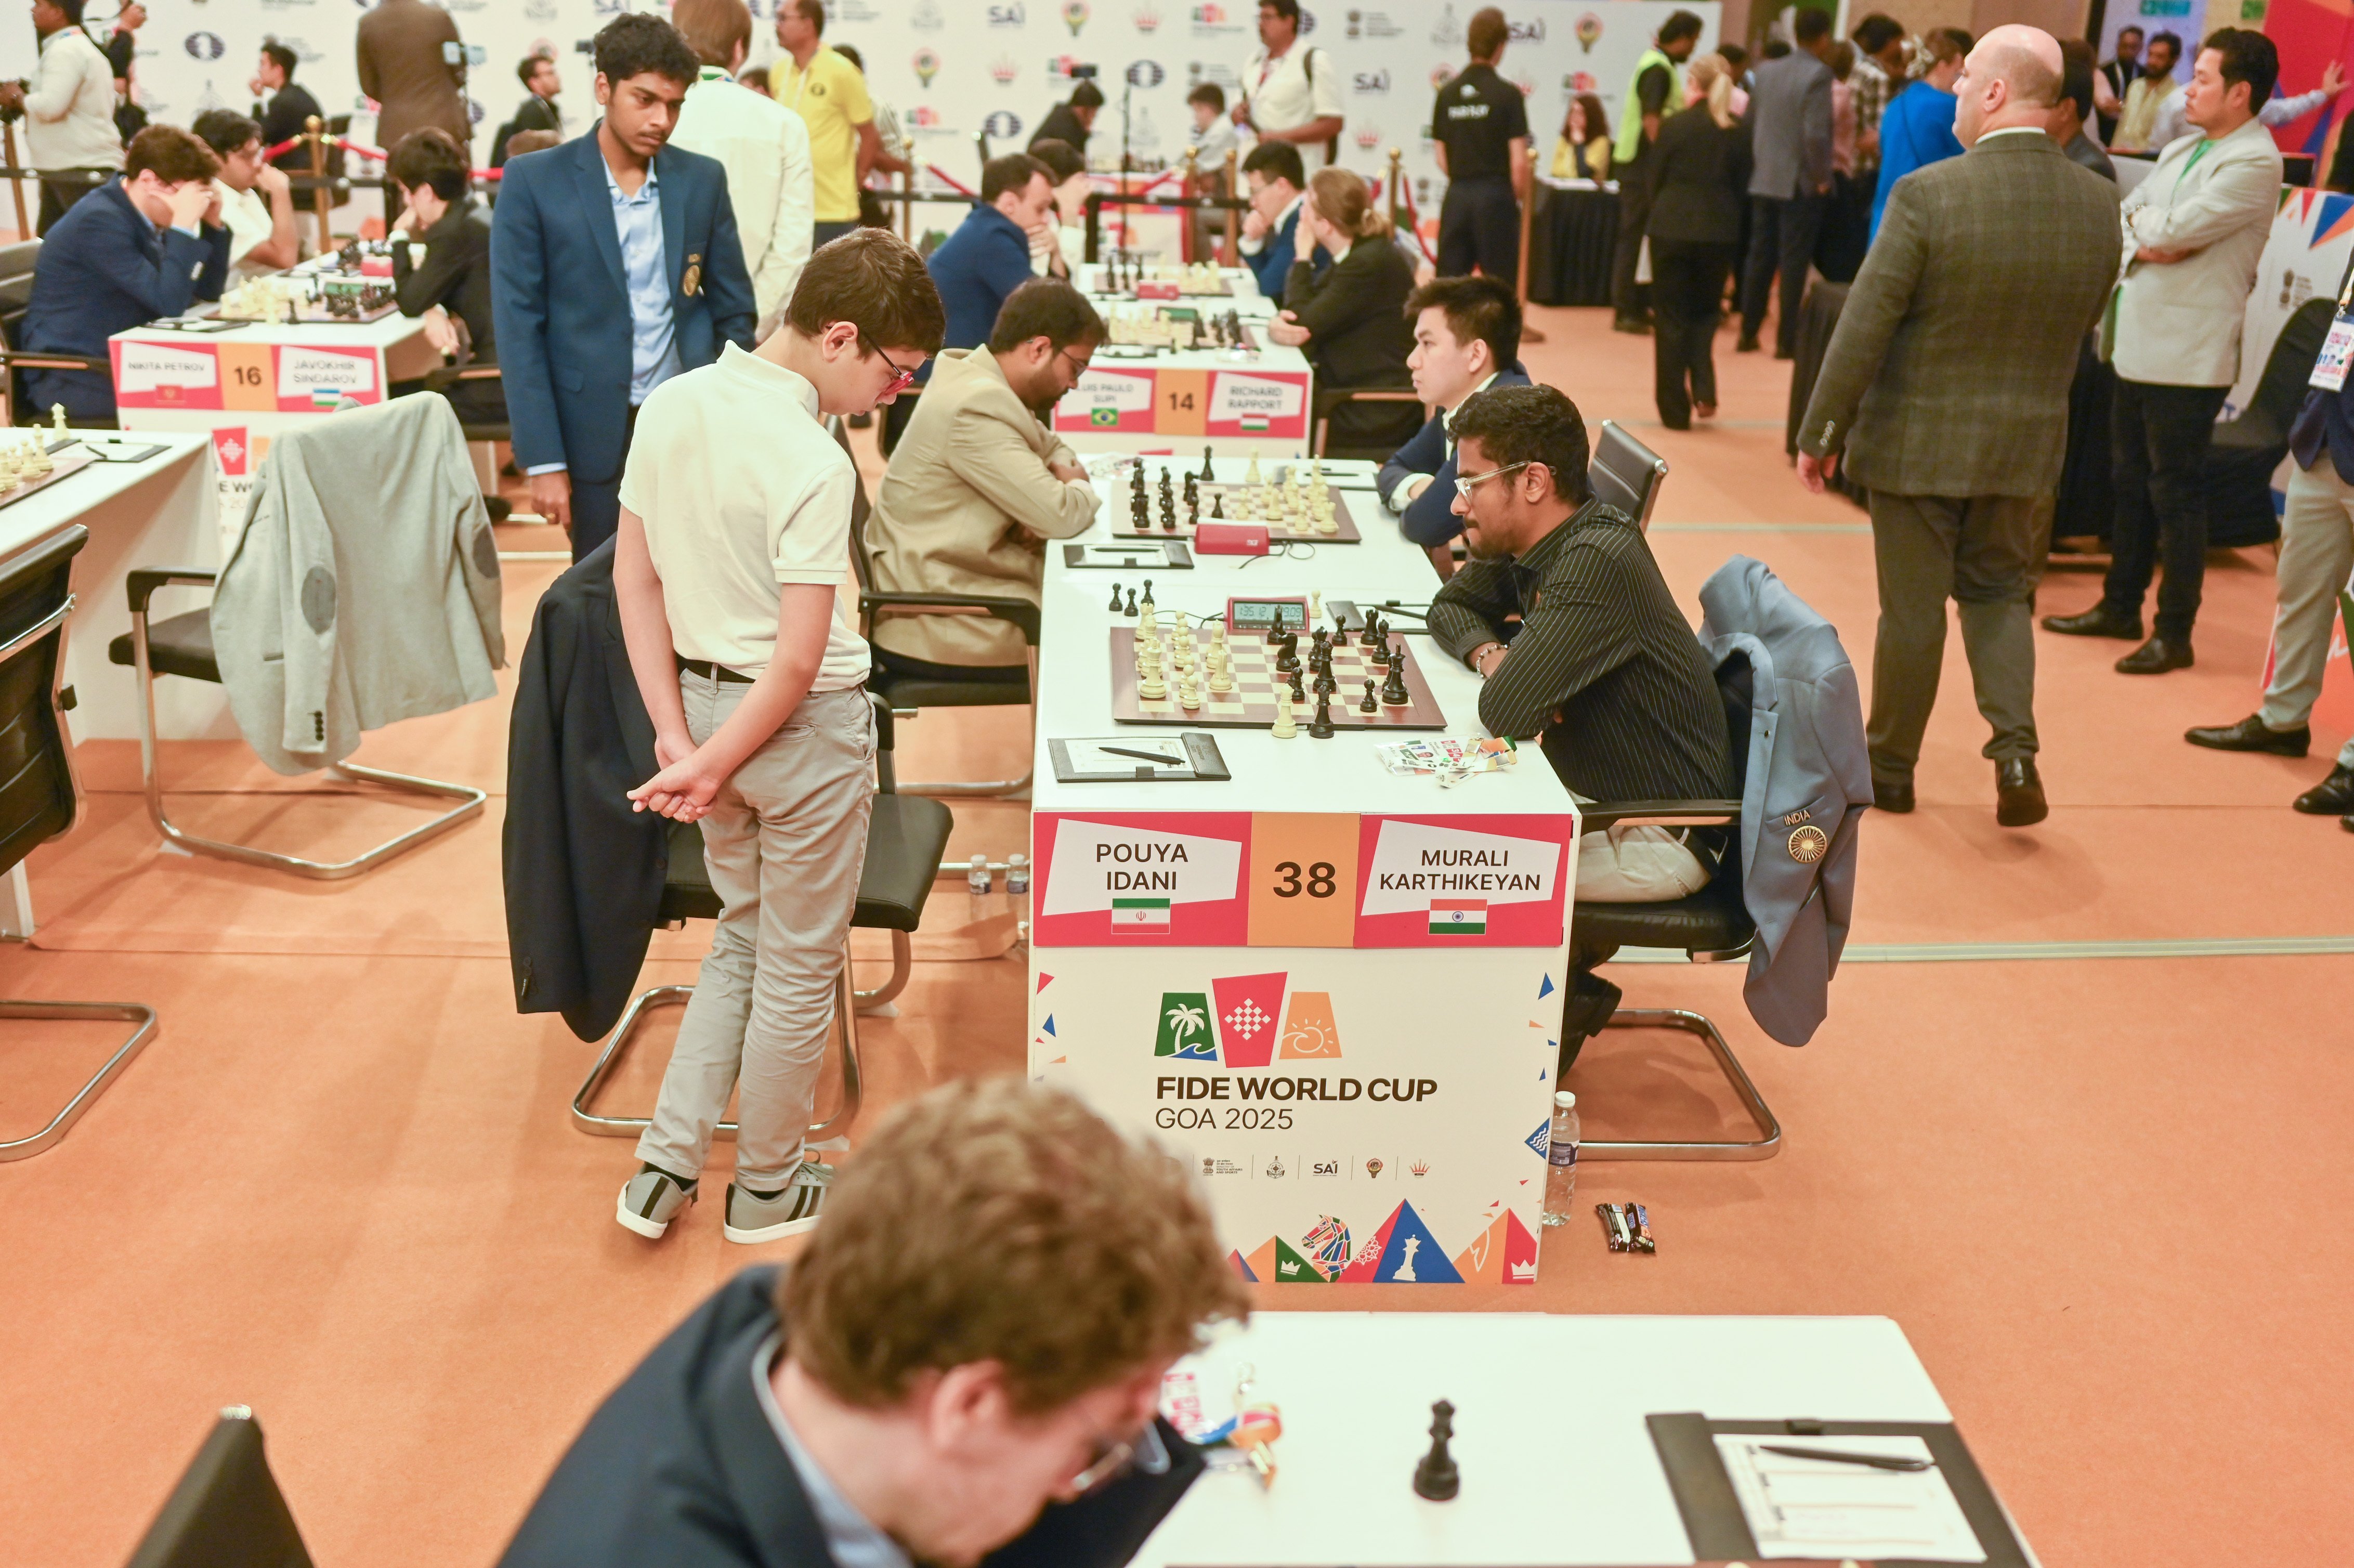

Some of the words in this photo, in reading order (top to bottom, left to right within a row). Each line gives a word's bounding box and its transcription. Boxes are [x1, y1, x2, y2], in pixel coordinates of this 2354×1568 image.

[129, 361, 161, 370] NIKITA
[165, 362, 205, 371] PETROV
[294, 359, 356, 369] JAVOKHIR
[234, 366, 262, 385] 16
[294, 373, 356, 383] SINDAROV
[1230, 386, 1283, 396] RICHARD
[1170, 393, 1194, 410] 14
[1228, 399, 1282, 409] RAPPORT
[1784, 809, 1810, 826] INDIA
[1096, 843, 1188, 863] POUYA
[1421, 850, 1509, 867] MURALI
[1107, 871, 1176, 890] IDANI
[1273, 861, 1336, 898] 38
[1380, 873, 1540, 891] KARTHIKEYAN
[1157, 1077, 1230, 1100] FIDE
[1237, 1077, 1362, 1101] WORLD
[1367, 1078, 1438, 1102] CUP
[1156, 1107, 1217, 1129] GOA
[1225, 1108, 1293, 1129] 2025
[1313, 1163, 1338, 1174] SAI
